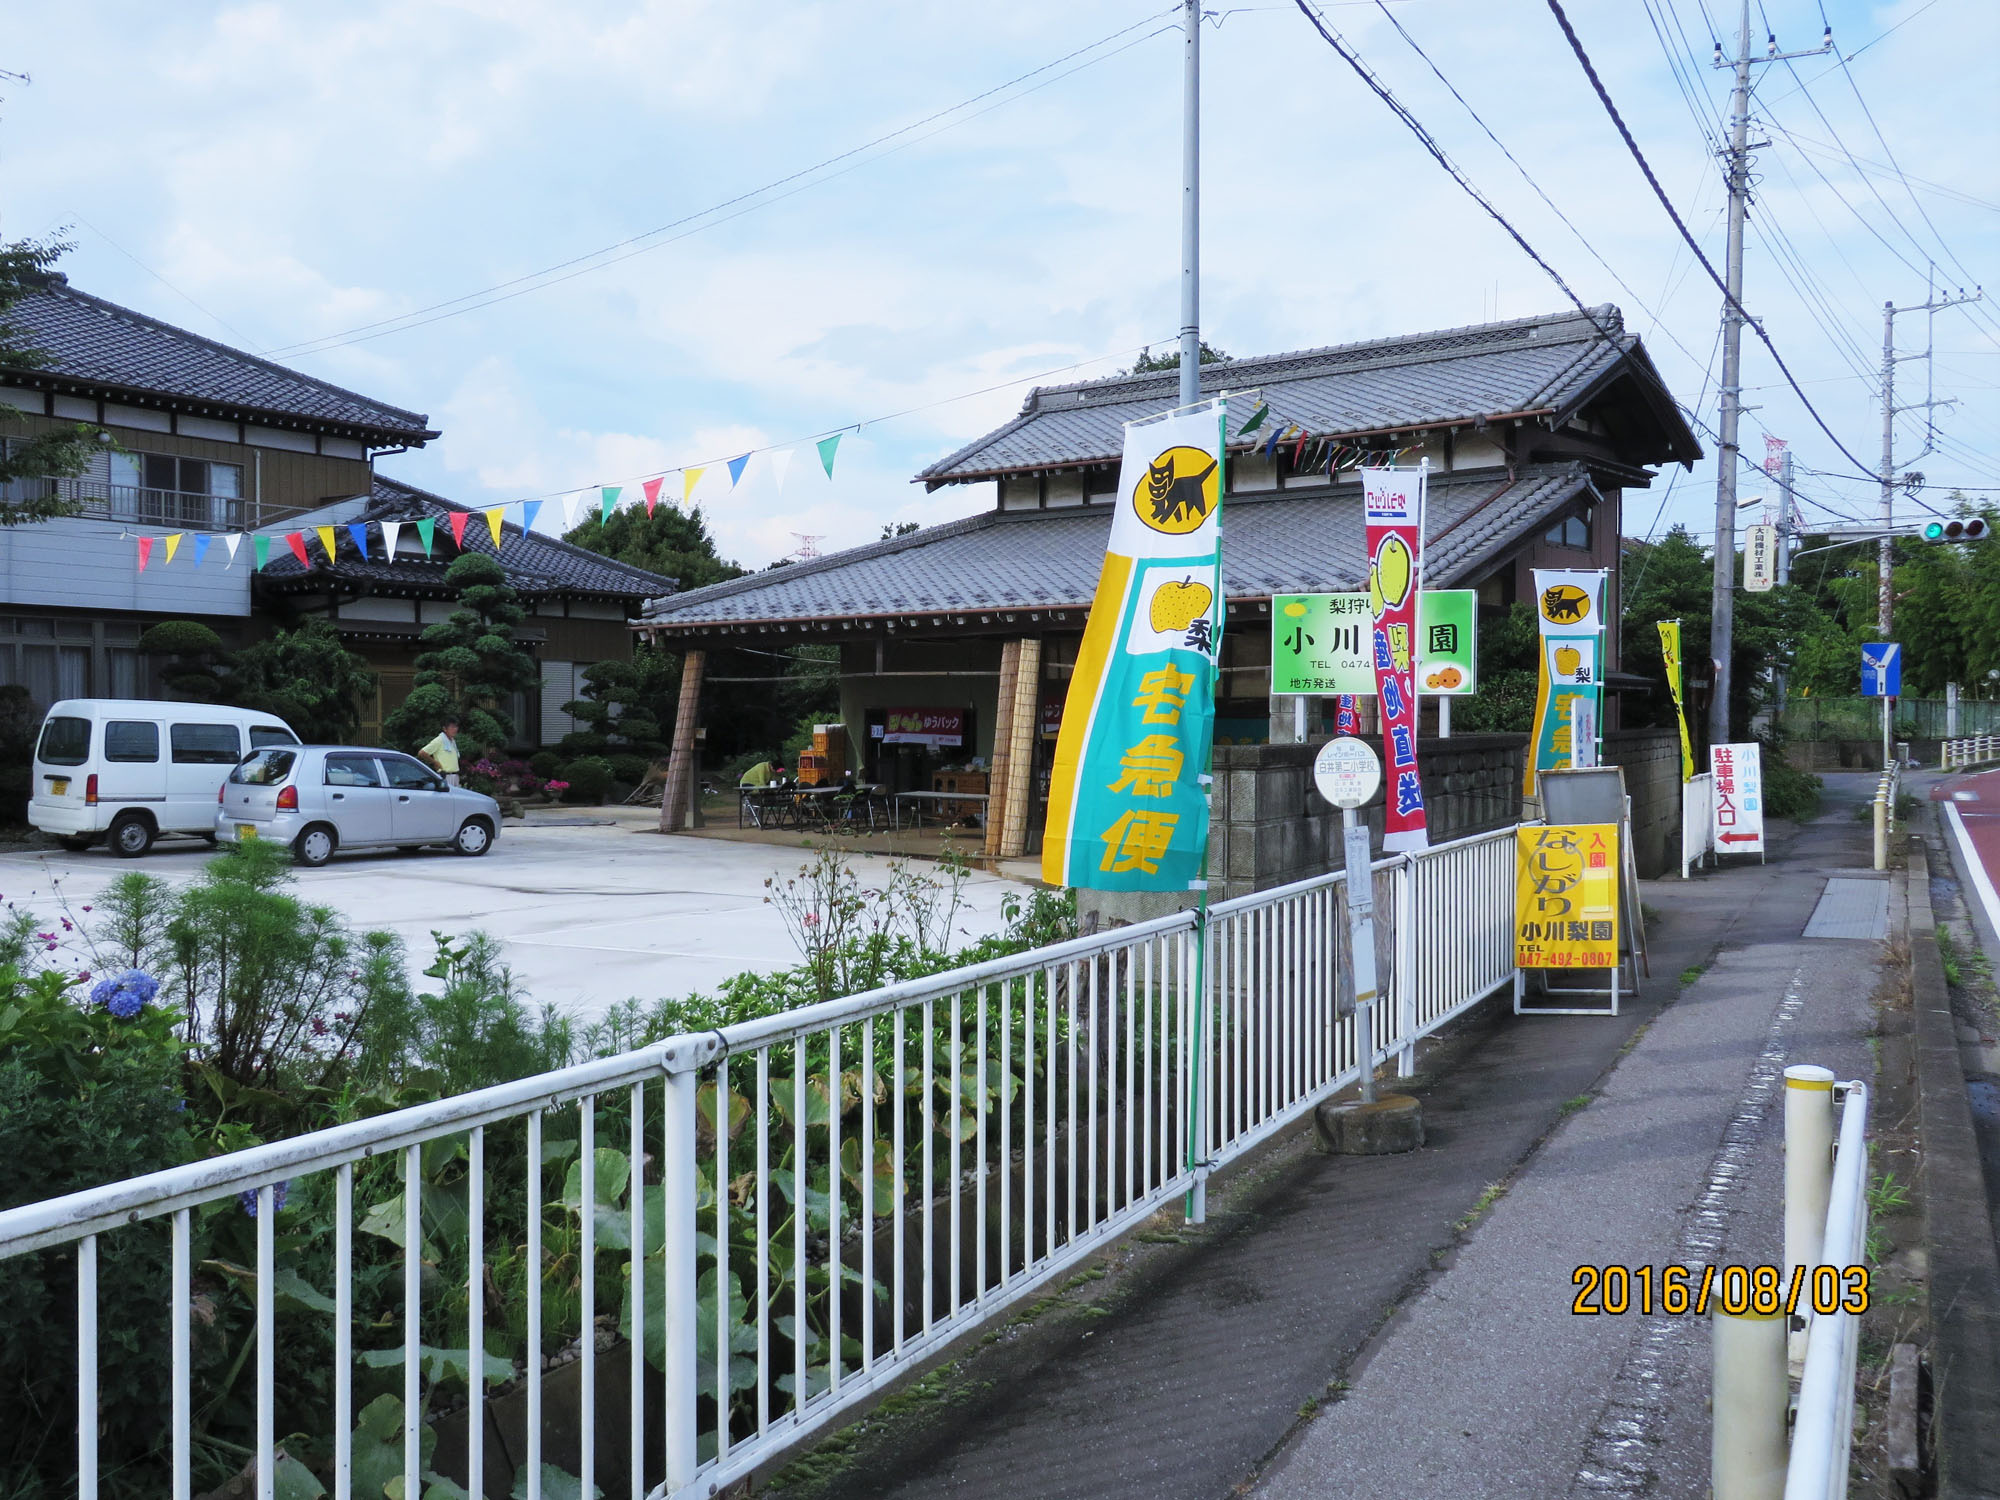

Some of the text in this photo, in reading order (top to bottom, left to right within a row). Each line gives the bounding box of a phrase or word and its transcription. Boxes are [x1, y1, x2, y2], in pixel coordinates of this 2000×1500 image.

[1184, 619, 1221, 656] 梨
[1284, 623, 1457, 655] 小川園
[1310, 660, 1331, 669] TEL
[1290, 678, 1336, 689] 地方発送
[1575, 667, 1591, 683] 梨
[923, 716, 960, 729] ゆうパック
[1100, 663, 1195, 875] 宅急便
[1319, 760, 1375, 773] 白井第二小学校
[1714, 747, 1736, 826] 駐車場入口
[1741, 749, 1757, 811] 小川梨園
[1533, 829, 1577, 917] なしがり
[1521, 920, 1613, 941] 小川梨園
[1518, 944, 1544, 952] TEL
[1518, 951, 1612, 966] 047-492-0807
